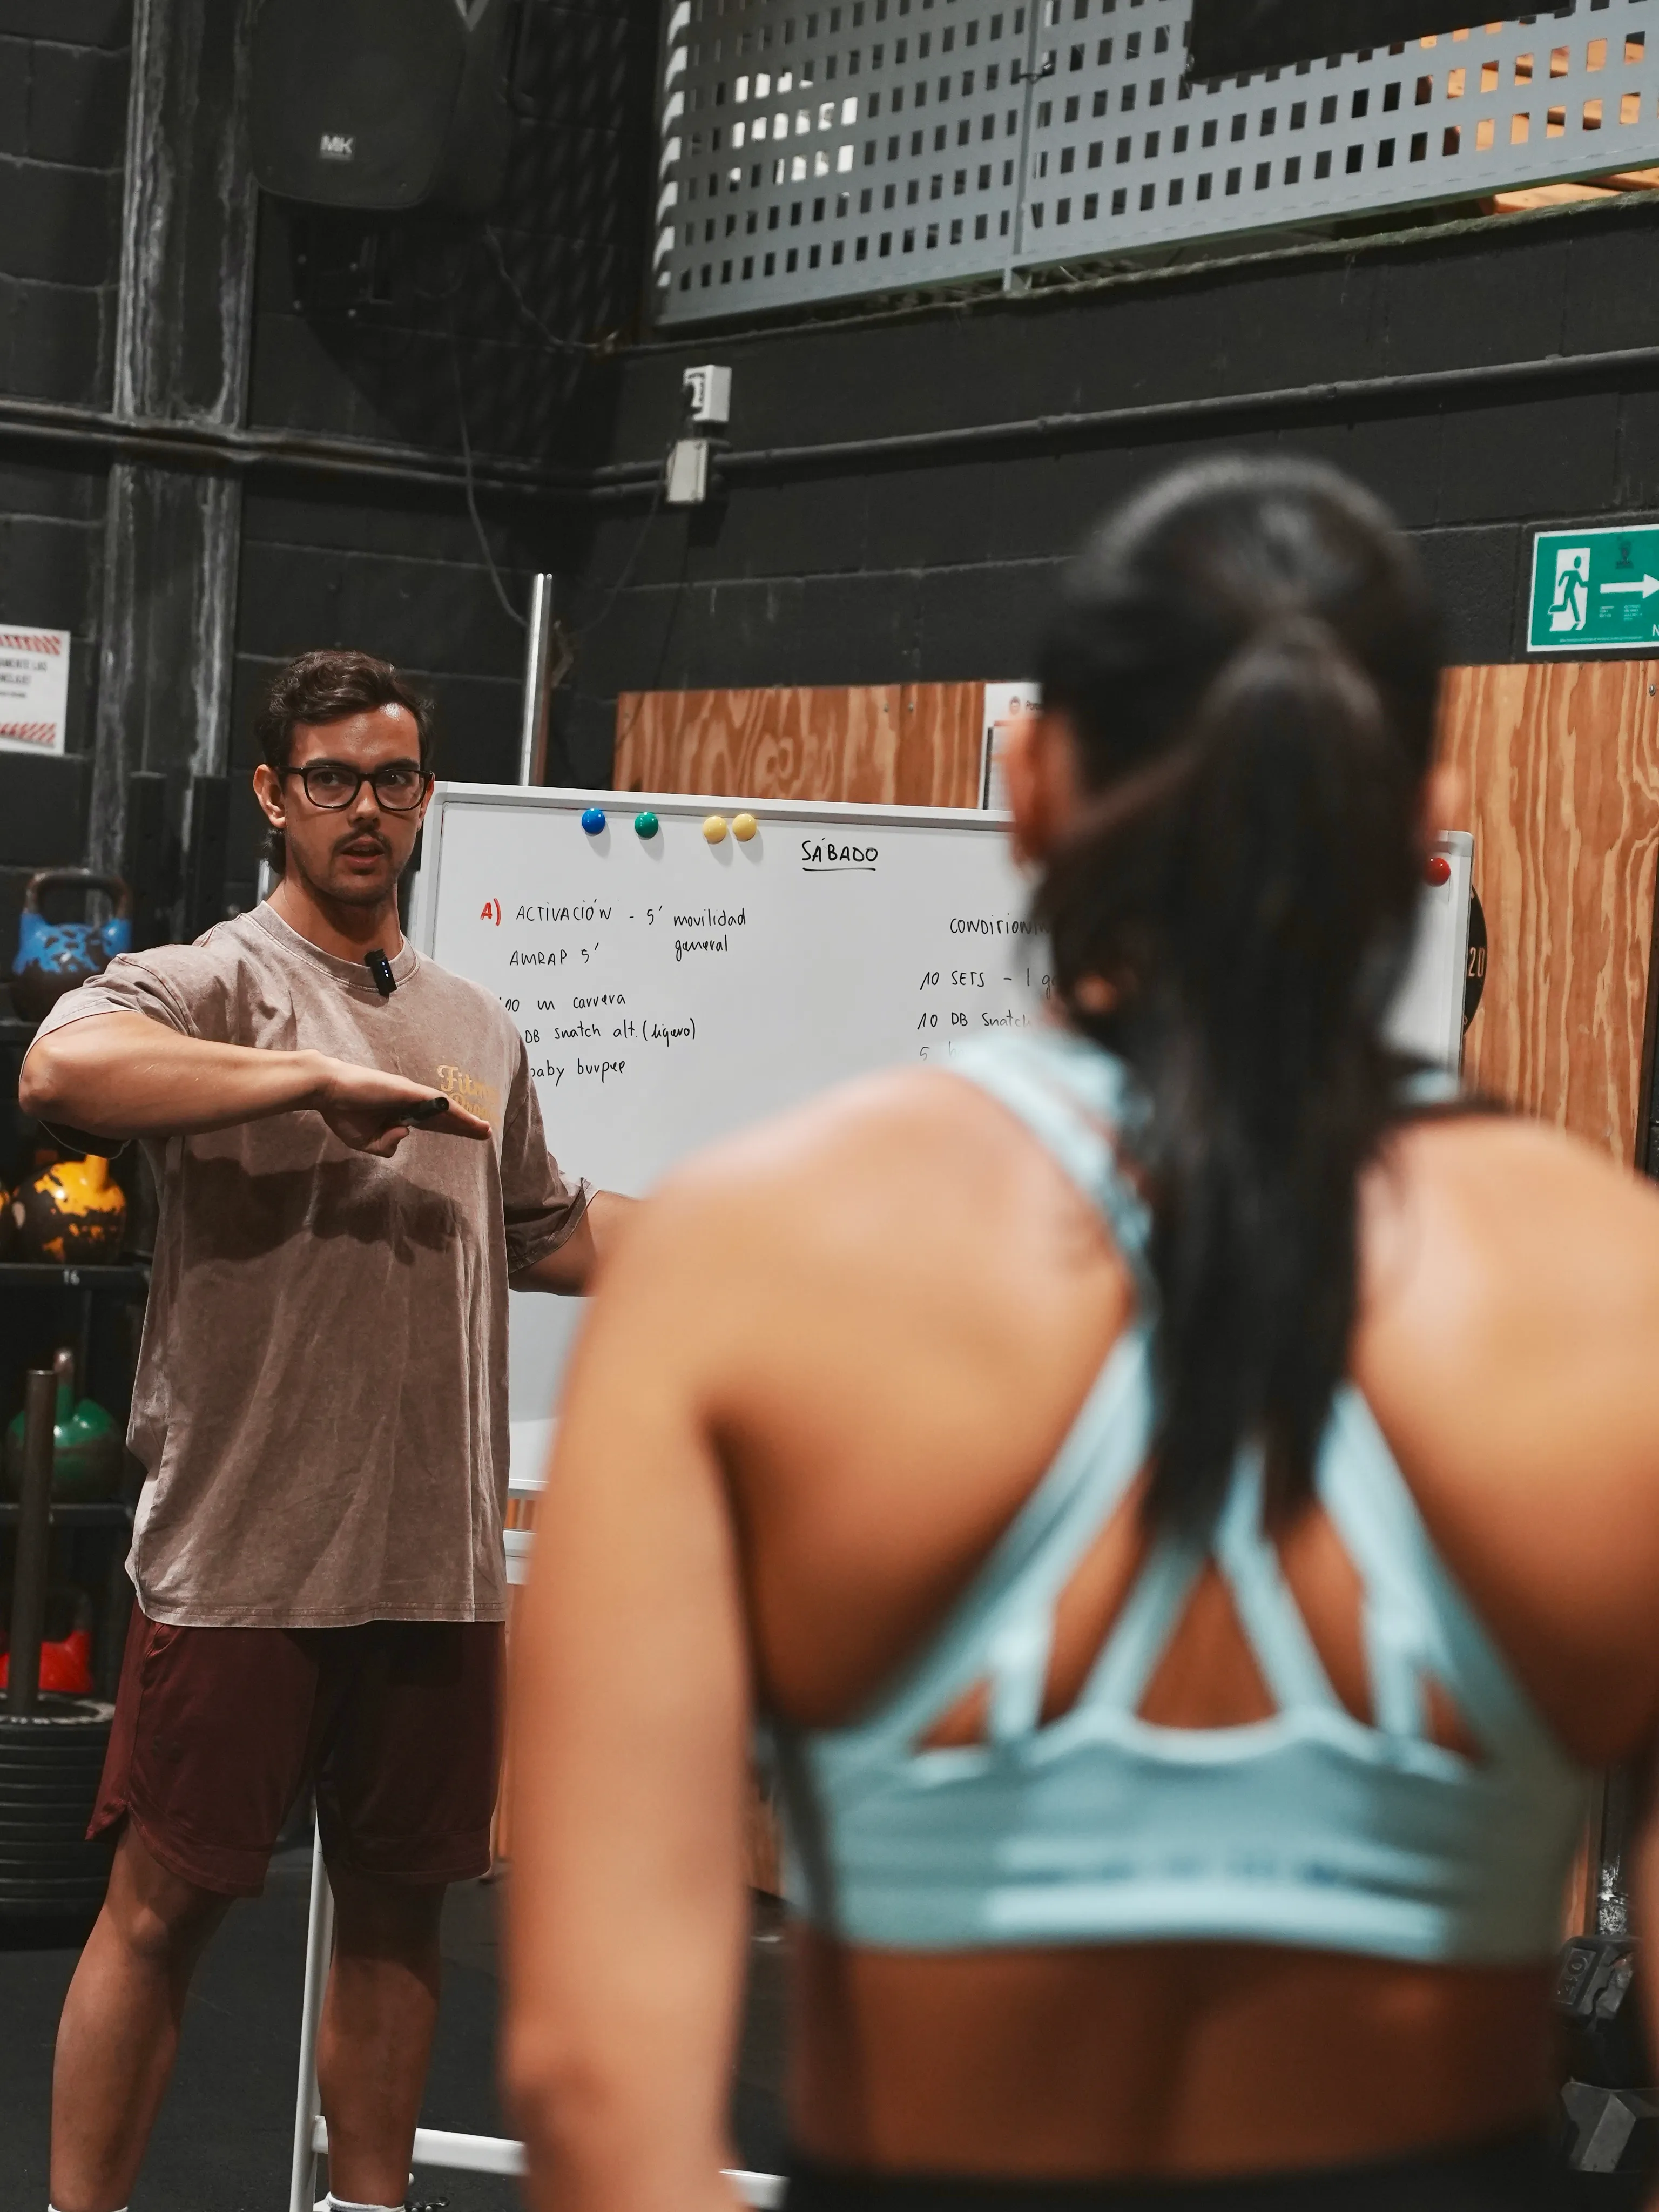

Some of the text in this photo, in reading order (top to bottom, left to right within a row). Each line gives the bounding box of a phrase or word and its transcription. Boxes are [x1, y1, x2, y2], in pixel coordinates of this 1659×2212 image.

[673, 907, 746, 927] movilidad
[509, 949, 567, 966] AMRAP
[675, 934, 728, 962] general
[1467, 947, 1486, 977] 20
[920, 971, 940, 991] 10
[951, 970, 984, 988] SETS
[499, 994, 626, 1013] 00 m carrera
[916, 1012, 938, 1030] 10
[951, 1011, 968, 1027] DB
[525, 1029, 541, 1043] DB
